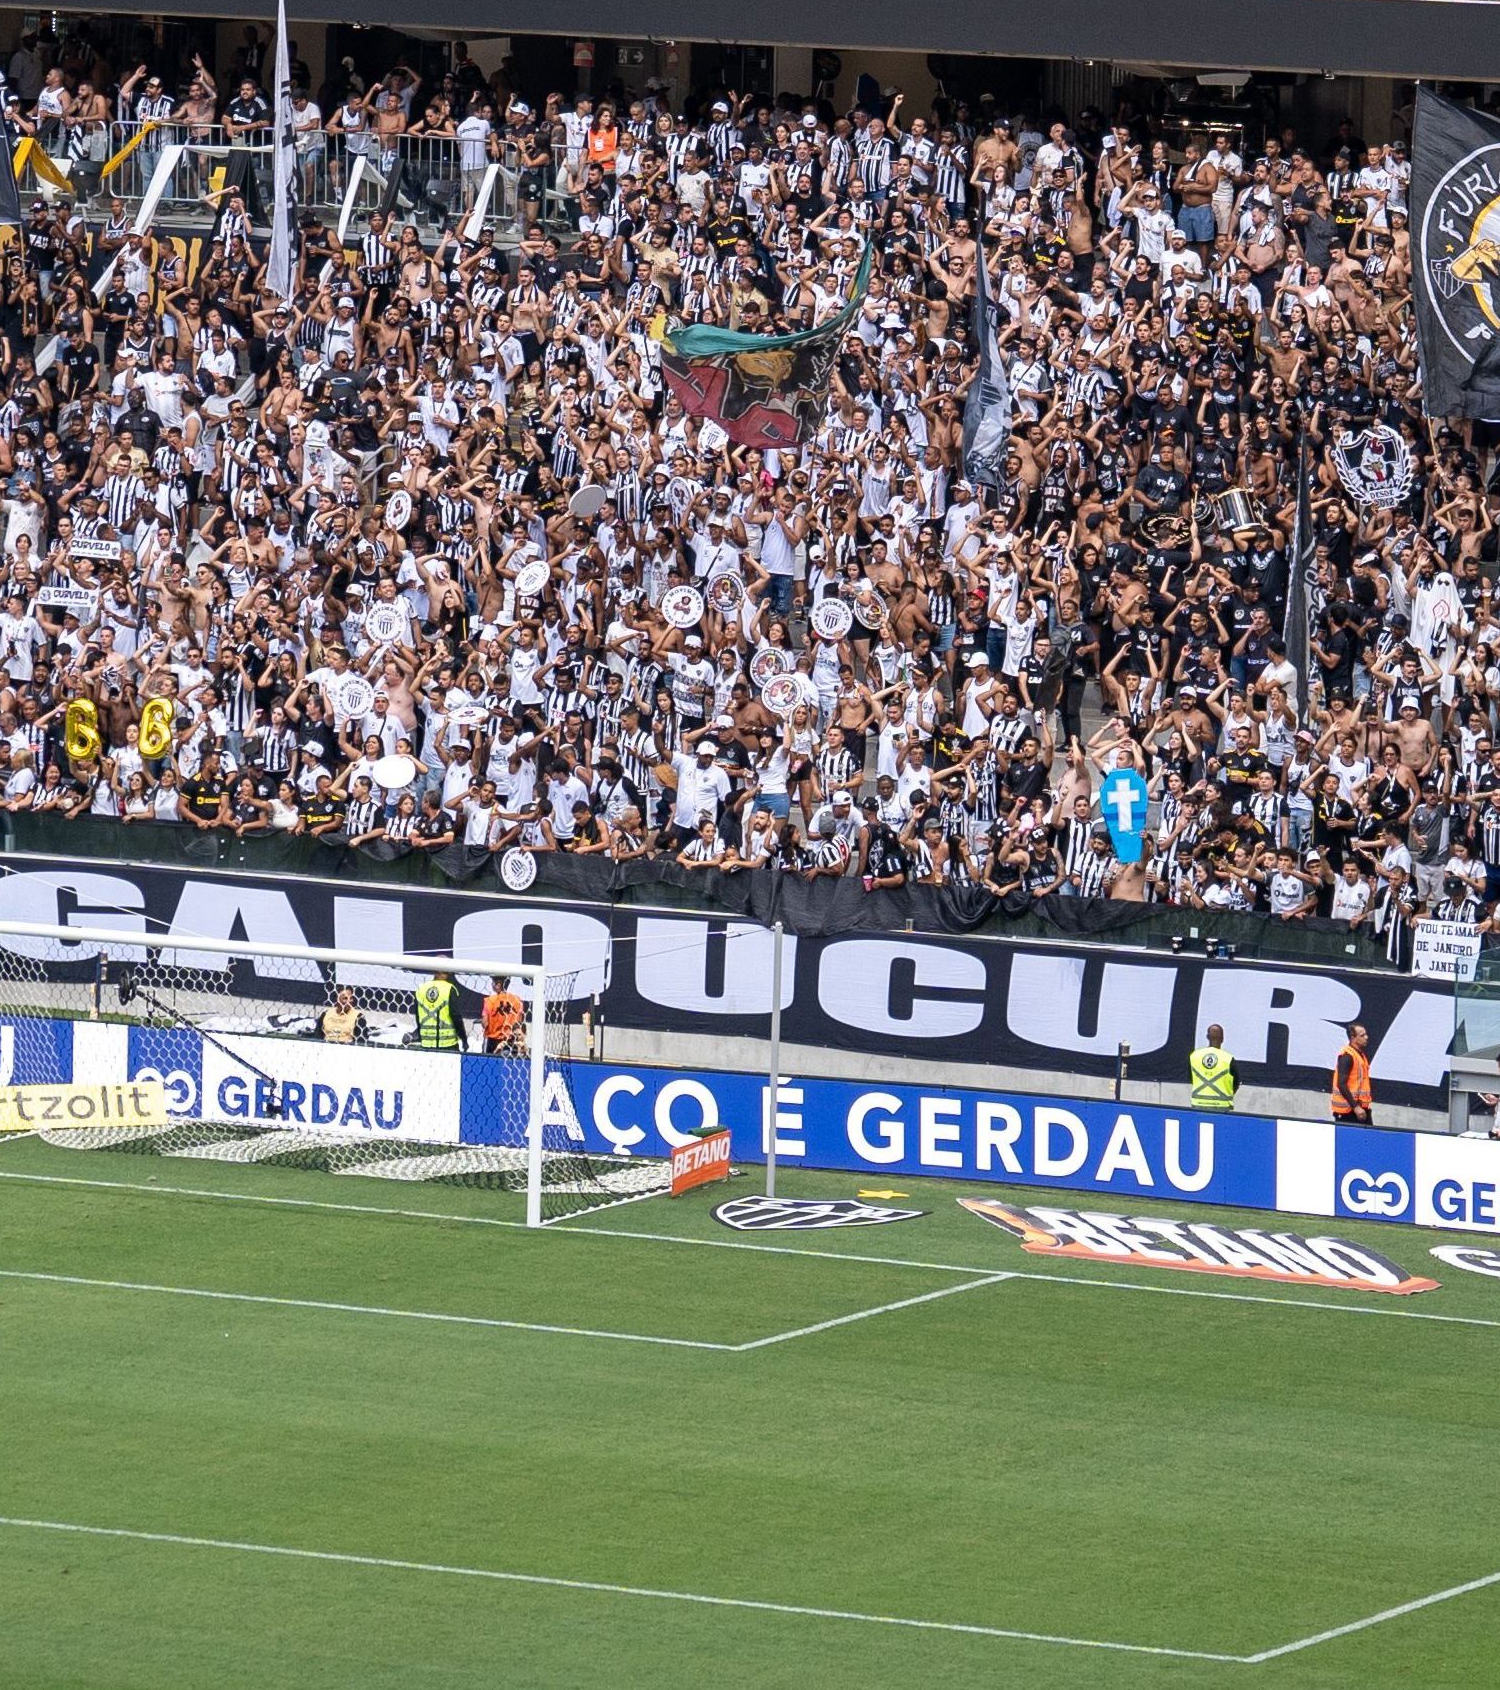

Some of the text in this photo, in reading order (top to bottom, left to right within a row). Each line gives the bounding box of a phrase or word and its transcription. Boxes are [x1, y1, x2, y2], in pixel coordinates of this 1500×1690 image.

[71, 540, 111, 552] CURVELO
[53, 590, 89, 599] CURVELO
[1419, 923, 1440, 936] VOU
[1441, 925, 1452, 936] TE
[1416, 940, 1429, 952] DE
[1414, 961, 1420, 970] A
[219, 1074, 404, 1134] GERDAU
[530, 1070, 1215, 1192] AÇO É GERDAU
[672, 1134, 731, 1182] BETANO
[1035, 1206, 1400, 1284] BETANO
